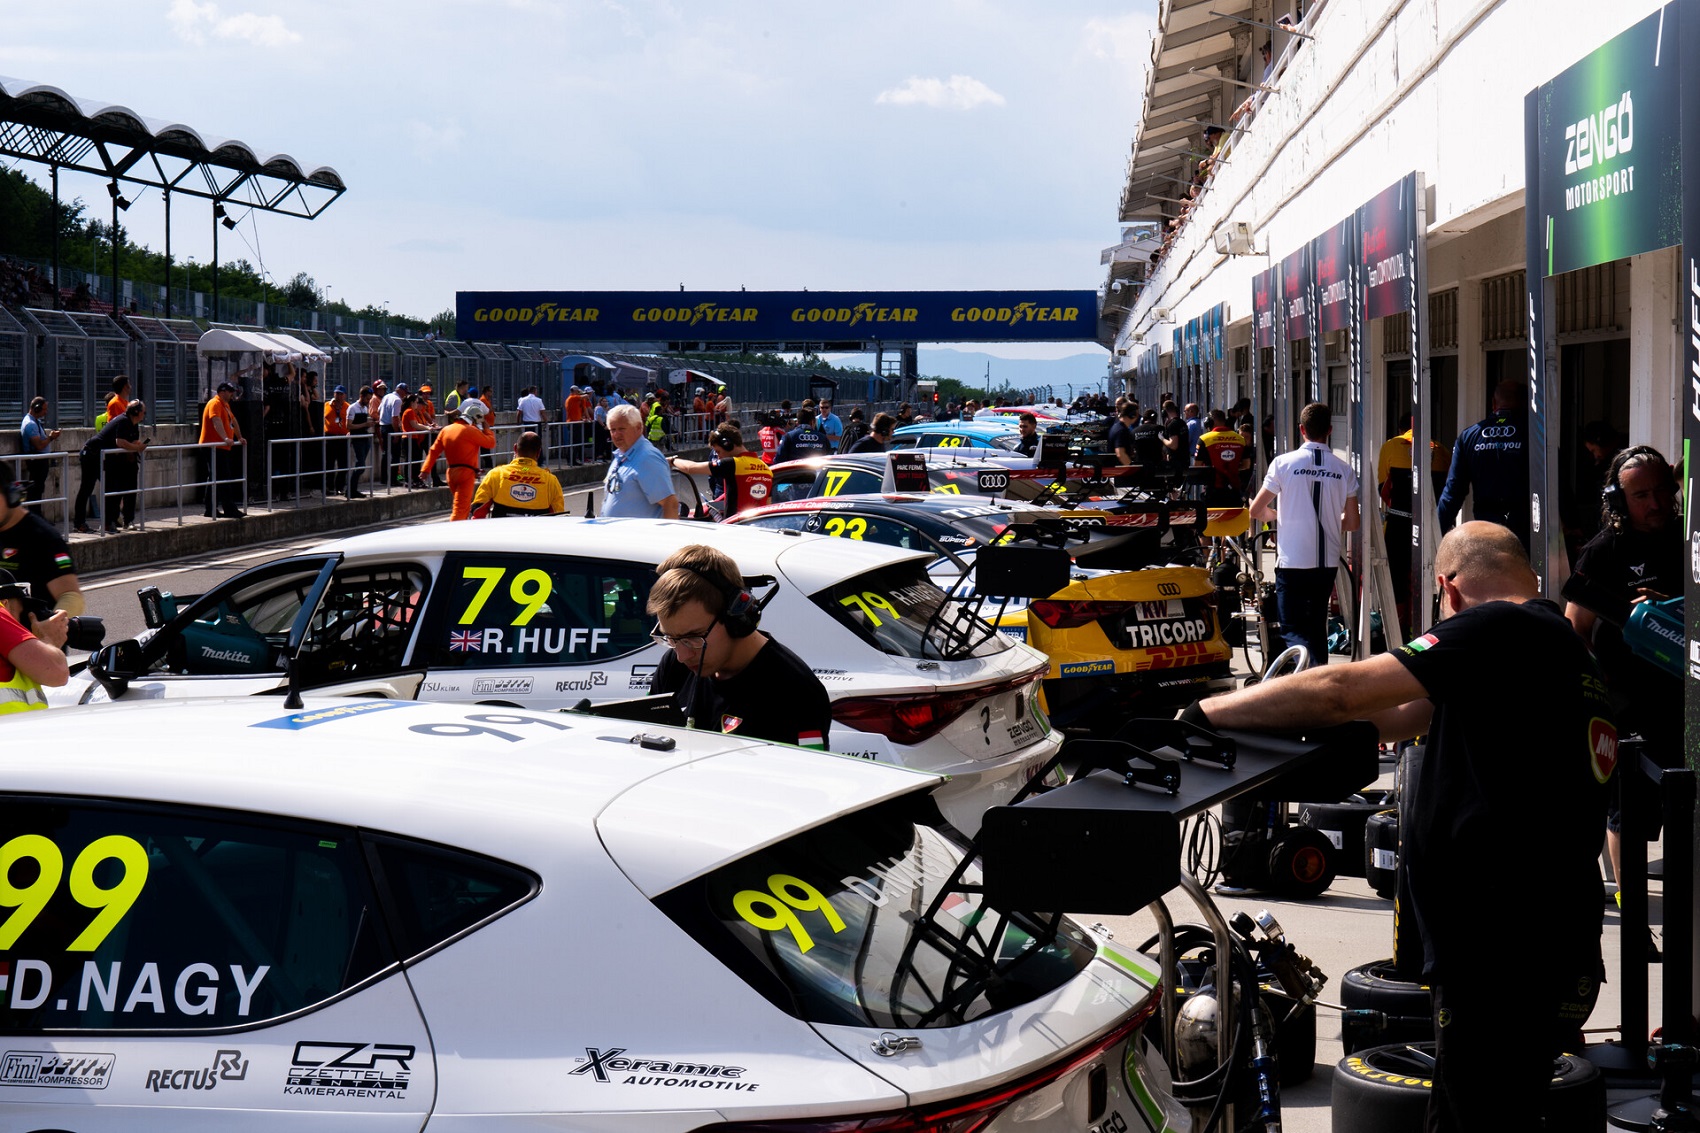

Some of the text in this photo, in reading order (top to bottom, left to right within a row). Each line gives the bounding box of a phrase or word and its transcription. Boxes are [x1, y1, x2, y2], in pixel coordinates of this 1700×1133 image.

[1565, 166, 1634, 210] MOTORSPORT
[1529, 292, 1537, 413] HUFF
[508, 474, 541, 484] DHL
[457, 566, 552, 626] 79
[839, 591, 901, 627] 79
[1142, 601, 1168, 619] KW
[482, 628, 611, 653] R.HUFF
[1126, 619, 1206, 647] TRICORP
[1146, 643, 1215, 669] DHL
[476, 680, 493, 691] Fini
[555, 679, 592, 691] RECTUS
[408, 714, 573, 743] 99
[0, 834, 149, 951] 99
[733, 874, 847, 954] 99
[10, 959, 271, 1016] D.NAGY
[291, 1041, 416, 1070] CZR
[568, 1047, 747, 1083] Xeramic
[4, 1057, 38, 1080] Fini
[38, 1076, 103, 1086] KOMPRESSOR
[146, 1067, 217, 1092] RECTUS
[288, 1067, 411, 1081] CZETTELE
[283, 1086, 406, 1099] KAMERARENTAL
[287, 1078, 408, 1089] RENTAL
[622, 1076, 760, 1092] AUTOMOTIVE
